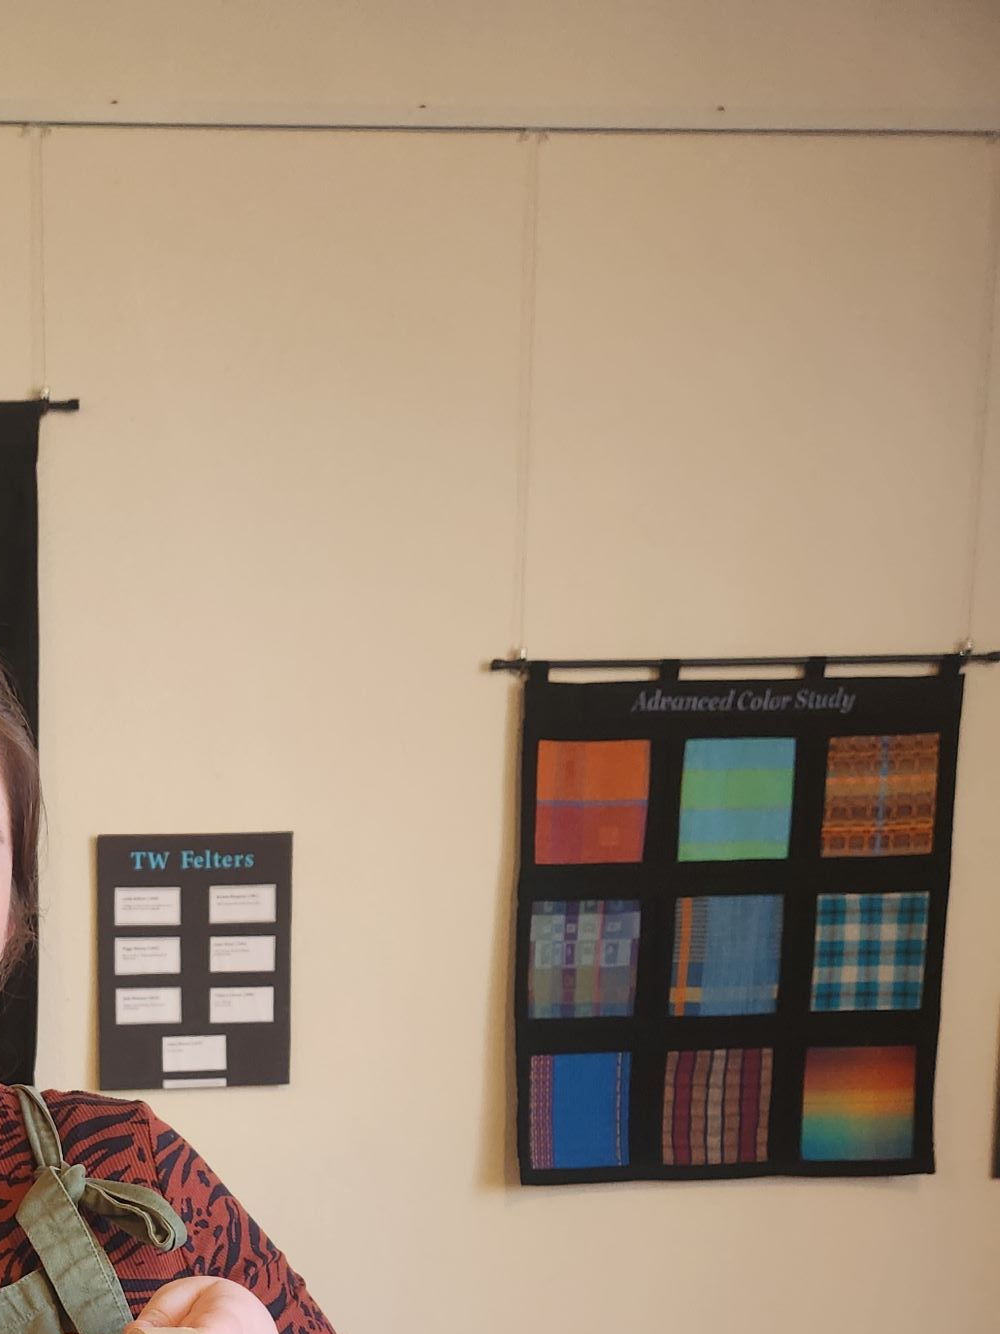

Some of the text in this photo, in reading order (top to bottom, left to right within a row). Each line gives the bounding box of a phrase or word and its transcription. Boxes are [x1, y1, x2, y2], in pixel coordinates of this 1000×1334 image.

[632, 686, 856, 714] Advanced Color Study
[130, 849, 255, 870] TW Felters
